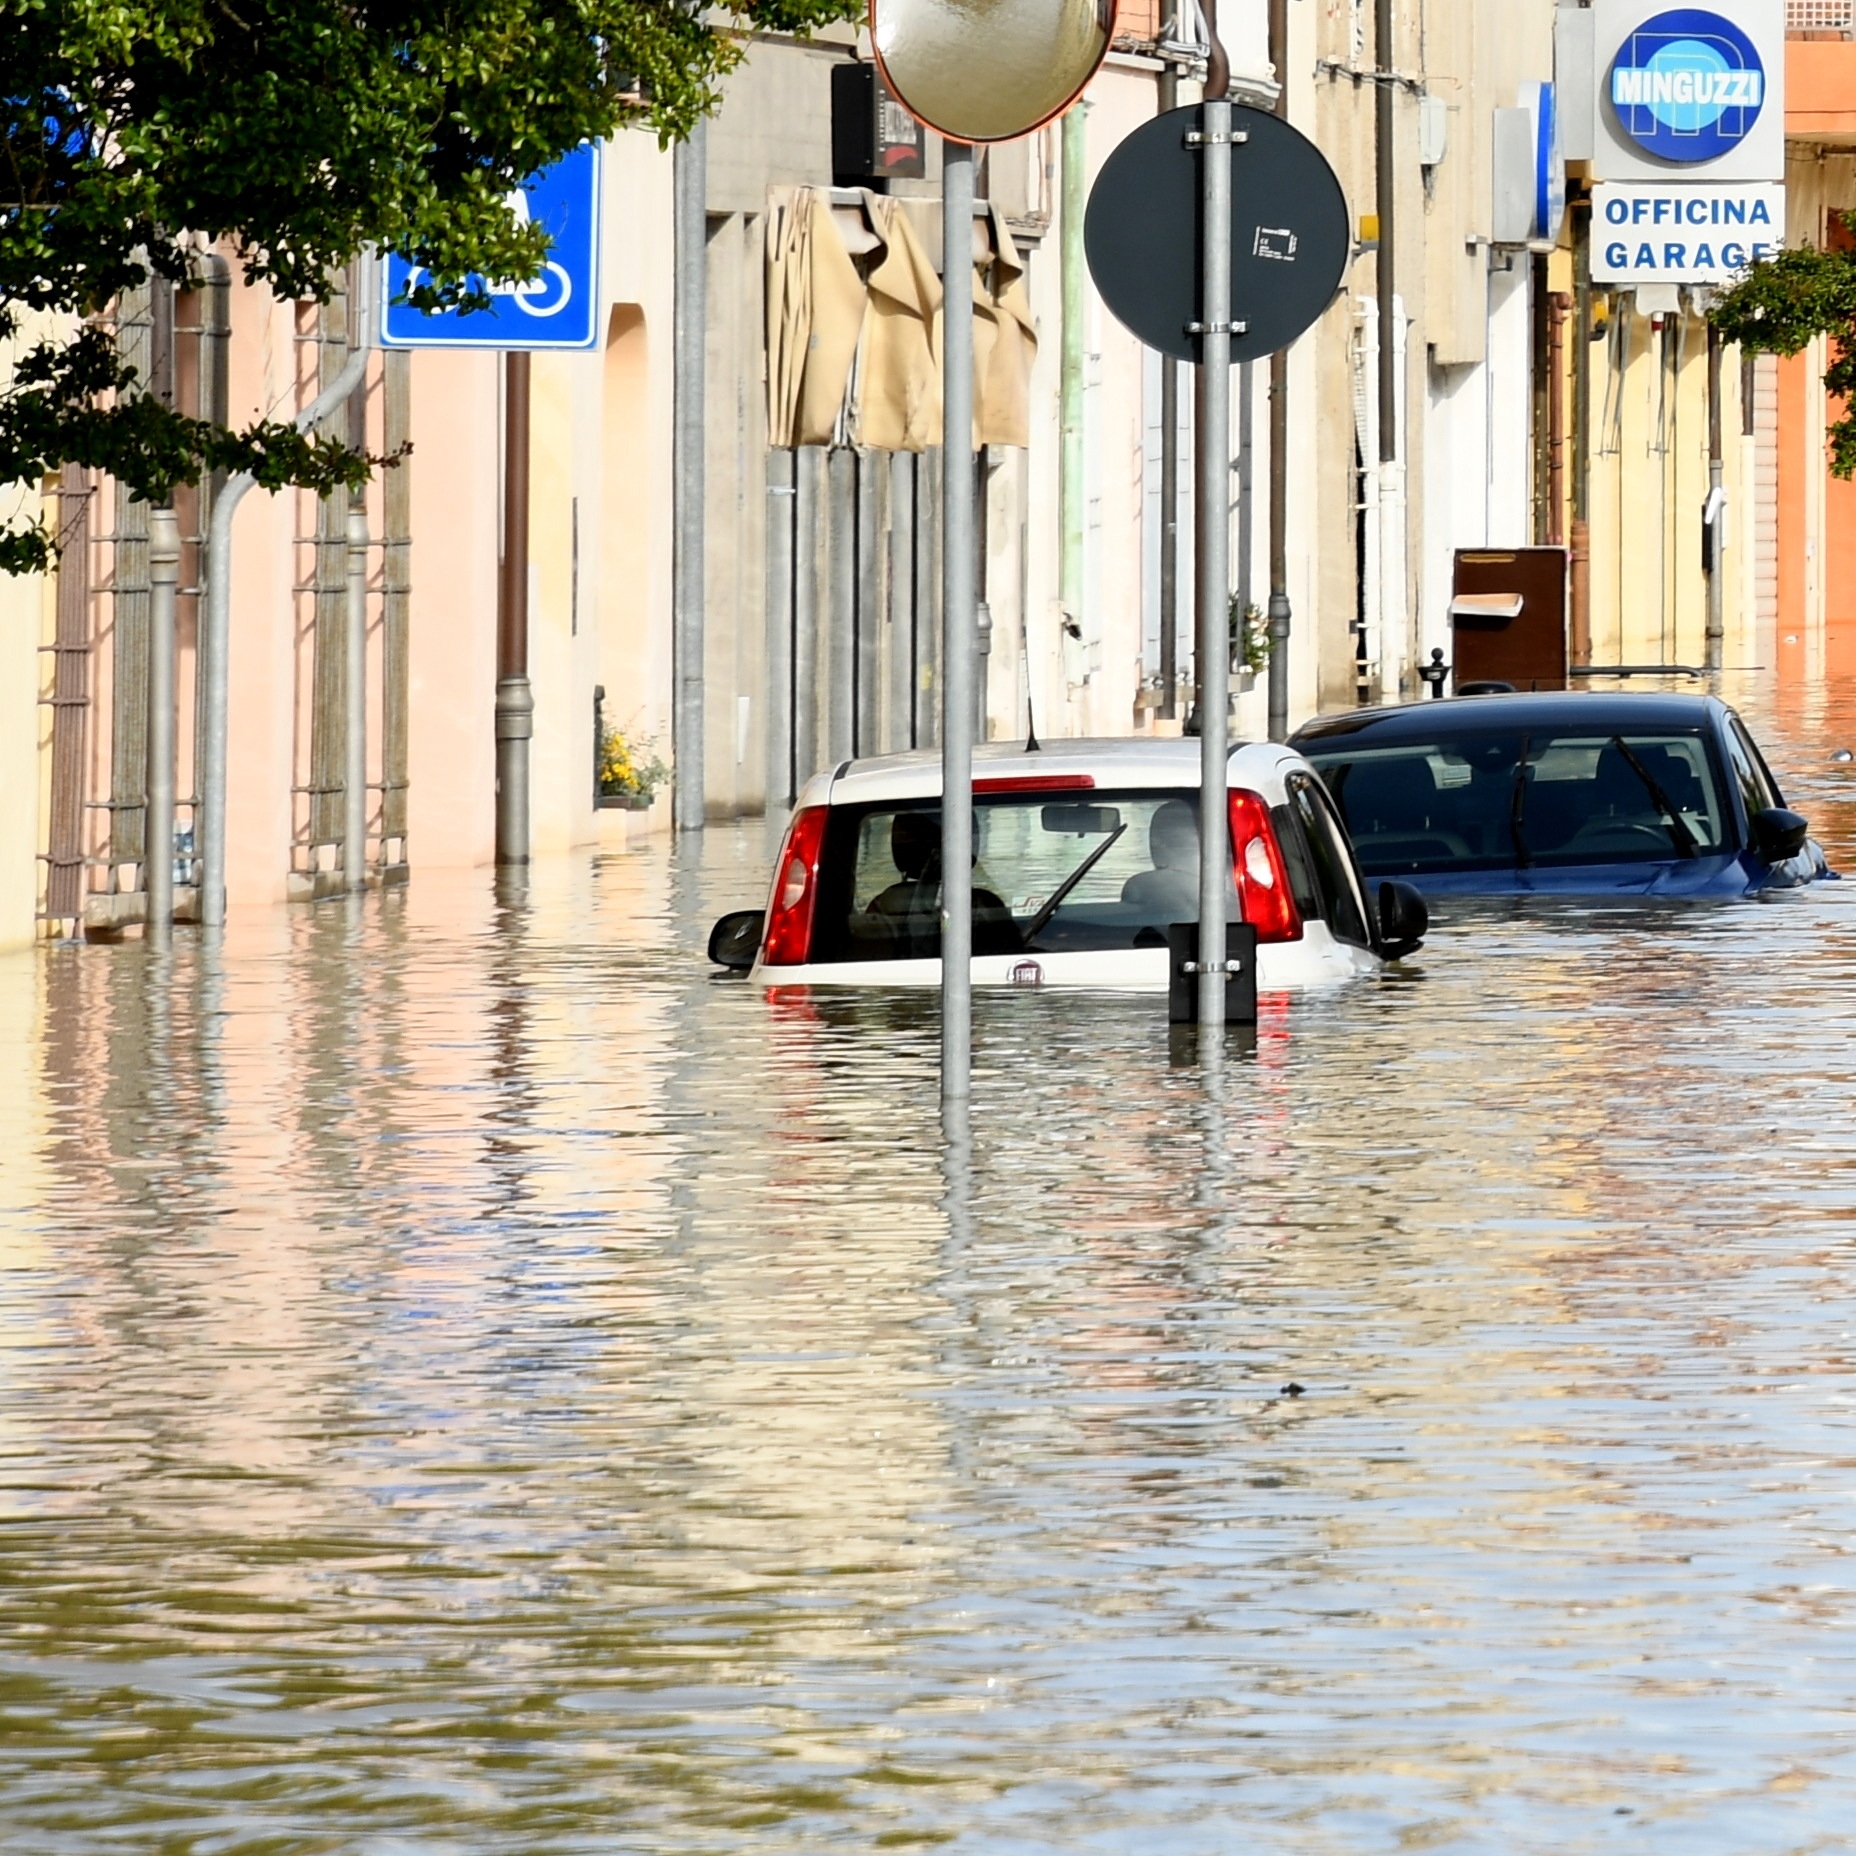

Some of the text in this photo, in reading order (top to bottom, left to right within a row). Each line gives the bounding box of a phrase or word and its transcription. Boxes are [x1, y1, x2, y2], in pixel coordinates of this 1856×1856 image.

[1617, 70, 1759, 105] MINGUZZI
[1605, 198, 1771, 225] OFFICINA
[1605, 242, 1771, 269] GARAGE
